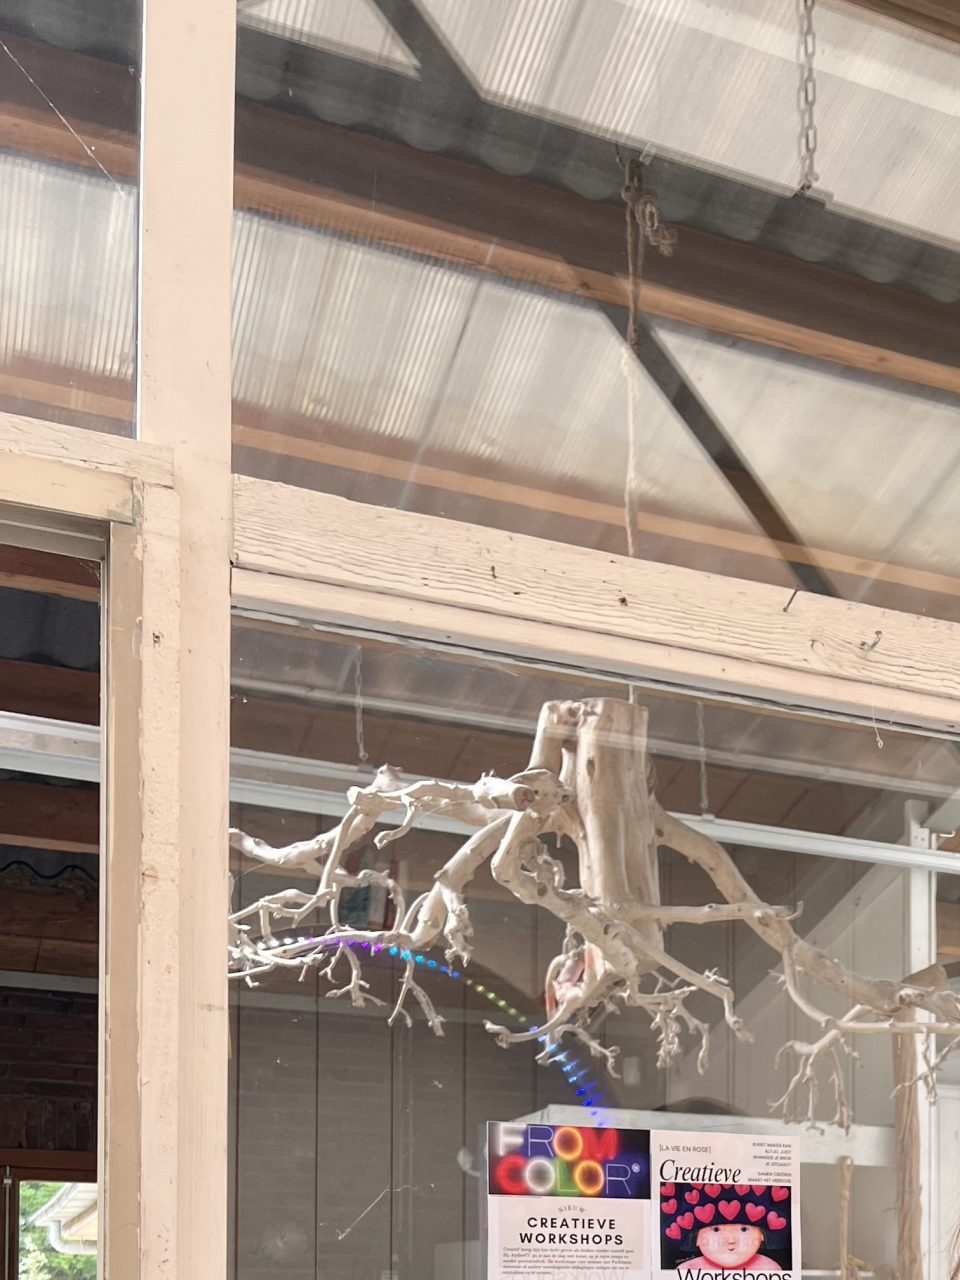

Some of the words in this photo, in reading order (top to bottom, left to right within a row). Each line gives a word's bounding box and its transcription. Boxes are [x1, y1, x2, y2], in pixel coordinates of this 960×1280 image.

[499, 1122, 619, 1161] FROM
[660, 1158, 741, 1183] Creatieve
[558, 1205, 586, 1213] NIEUW
[527, 1217, 616, 1229] CREATIEVE
[519, 1233, 623, 1246] WORKSHOPS
